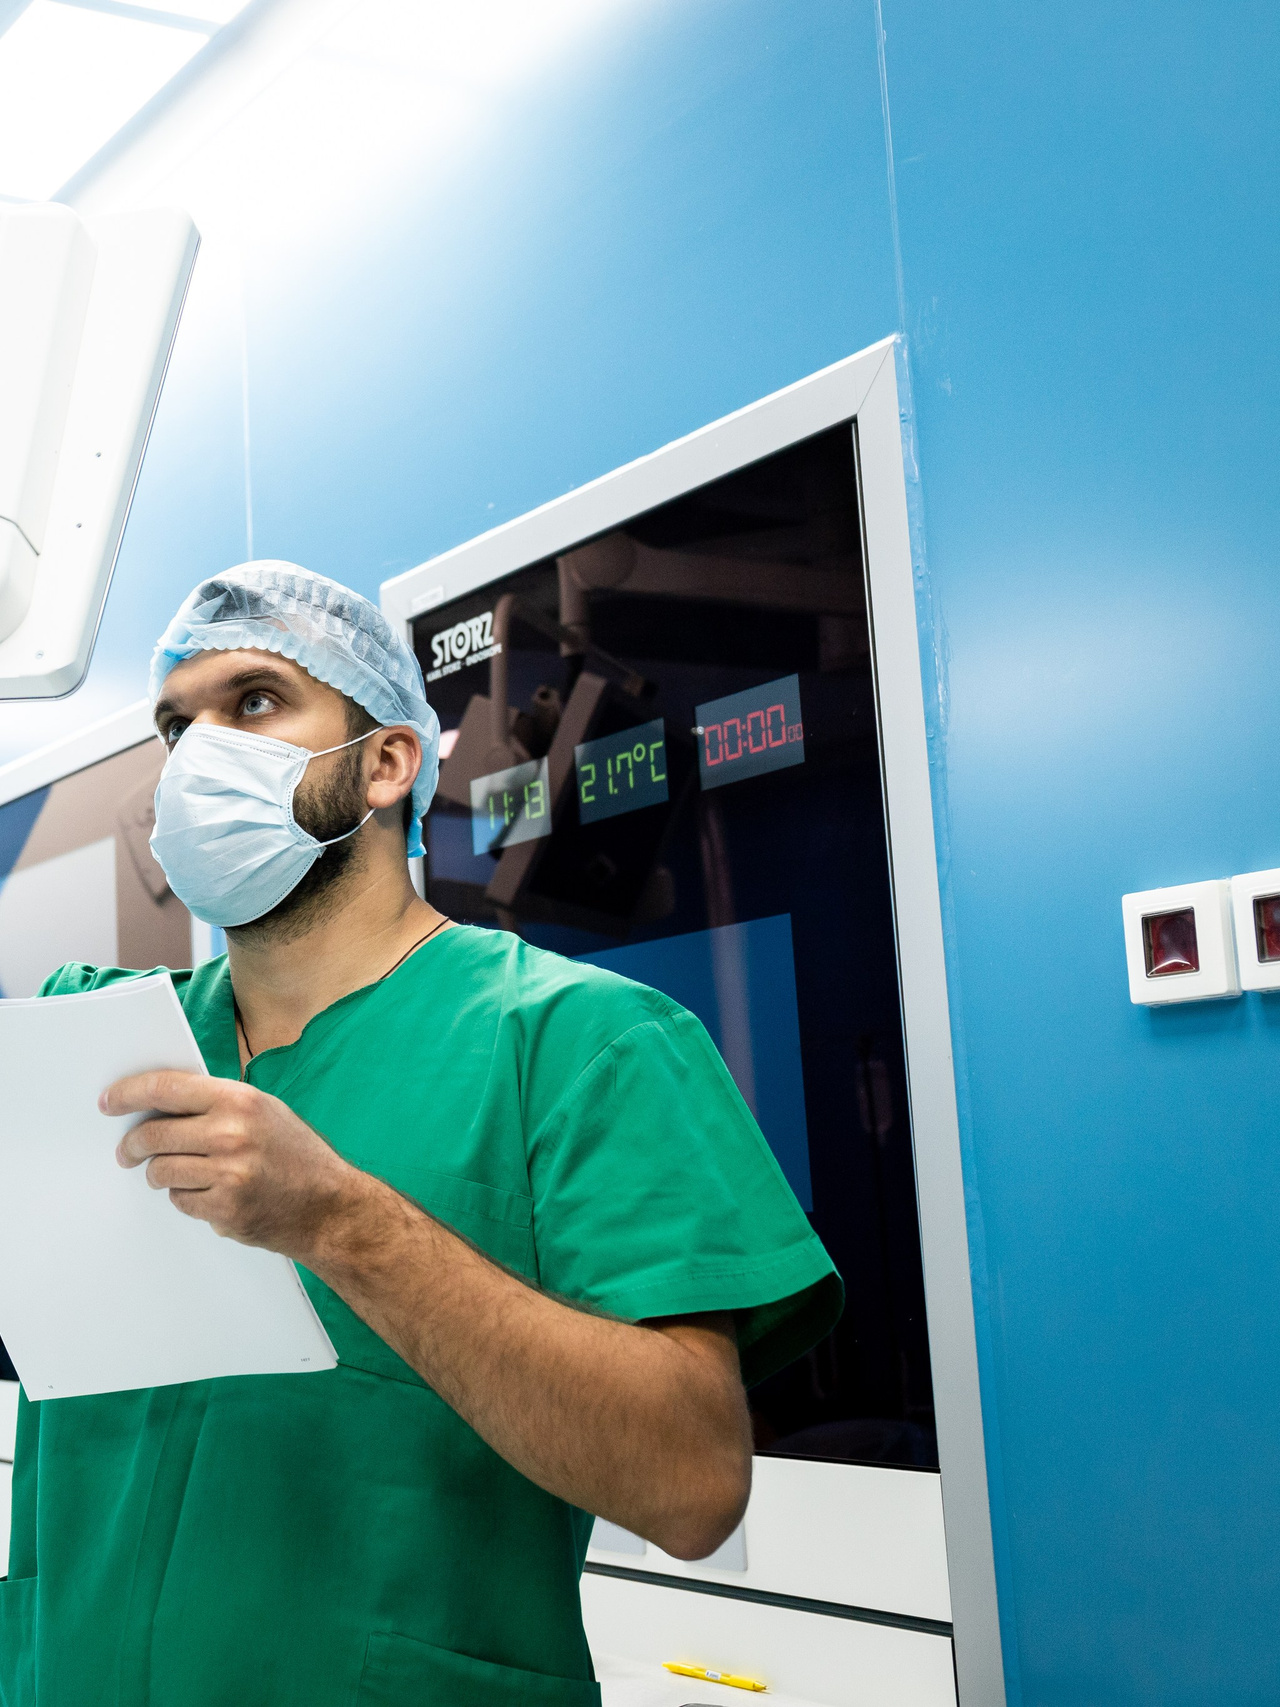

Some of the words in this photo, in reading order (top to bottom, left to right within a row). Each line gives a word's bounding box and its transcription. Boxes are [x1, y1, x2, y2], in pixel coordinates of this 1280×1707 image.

[431, 611, 494, 668] STORZ
[704, 704, 787, 766] 00:00
[580, 741, 666, 804] 21.7°C
[489, 780, 545, 830] 11:13
